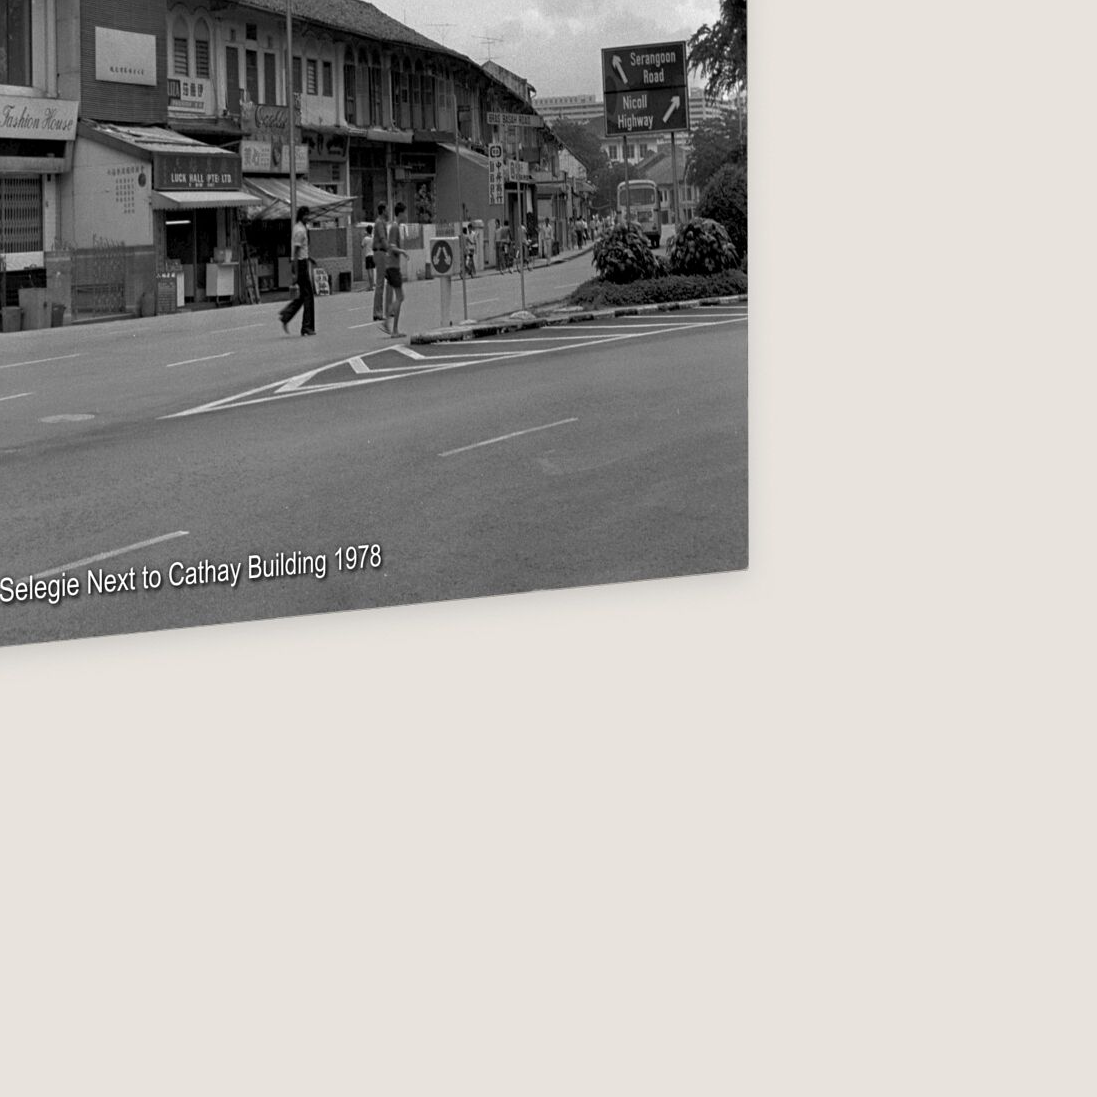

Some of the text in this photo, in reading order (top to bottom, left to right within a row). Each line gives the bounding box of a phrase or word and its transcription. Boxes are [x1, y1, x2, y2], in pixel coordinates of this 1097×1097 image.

[630, 51, 676, 67] Serangoon
[643, 68, 665, 83] Road
[623, 94, 648, 109] Nicoll
[0, 104, 40, 129] Fashion
[42, 107, 74, 131] House
[617, 113, 653, 131] Highway
[171, 173, 187, 183] LUCK
[189, 173, 204, 183] HALL
